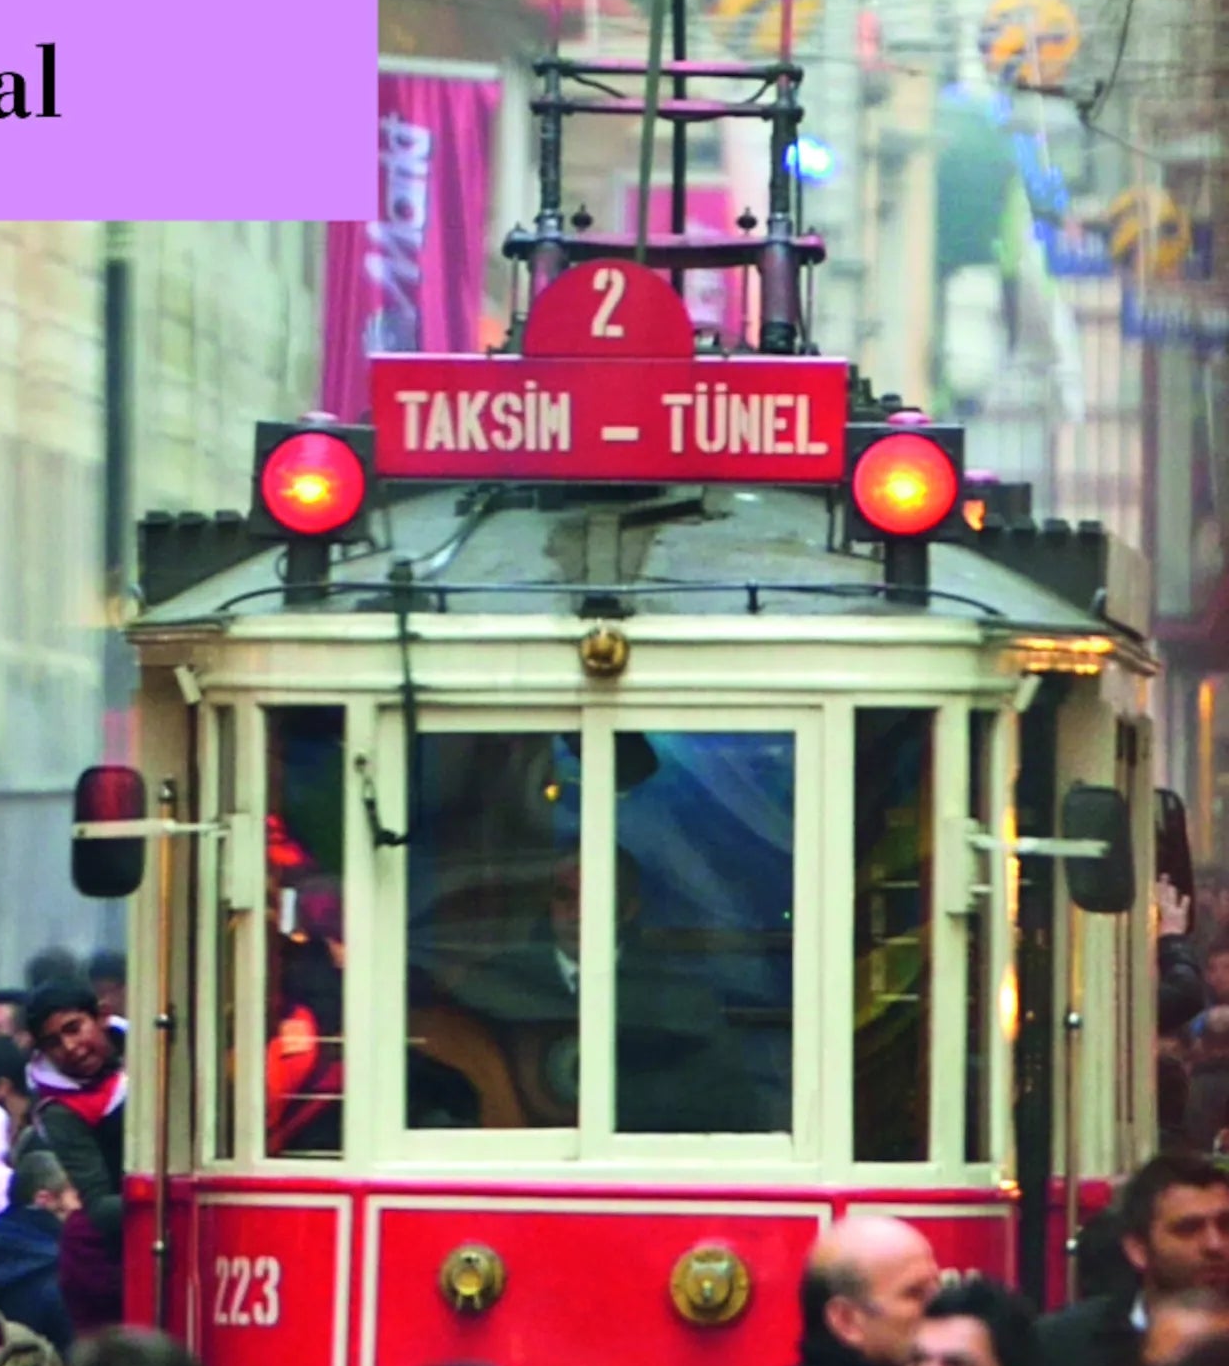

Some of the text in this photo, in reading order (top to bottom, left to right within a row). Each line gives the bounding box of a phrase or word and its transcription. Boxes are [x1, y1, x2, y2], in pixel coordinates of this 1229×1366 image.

[591, 268, 625, 338] 2
[395, 380, 571, 452] TAKSİM
[661, 382, 829, 455] TÜNEL
[215, 1256, 280, 1325] 223
